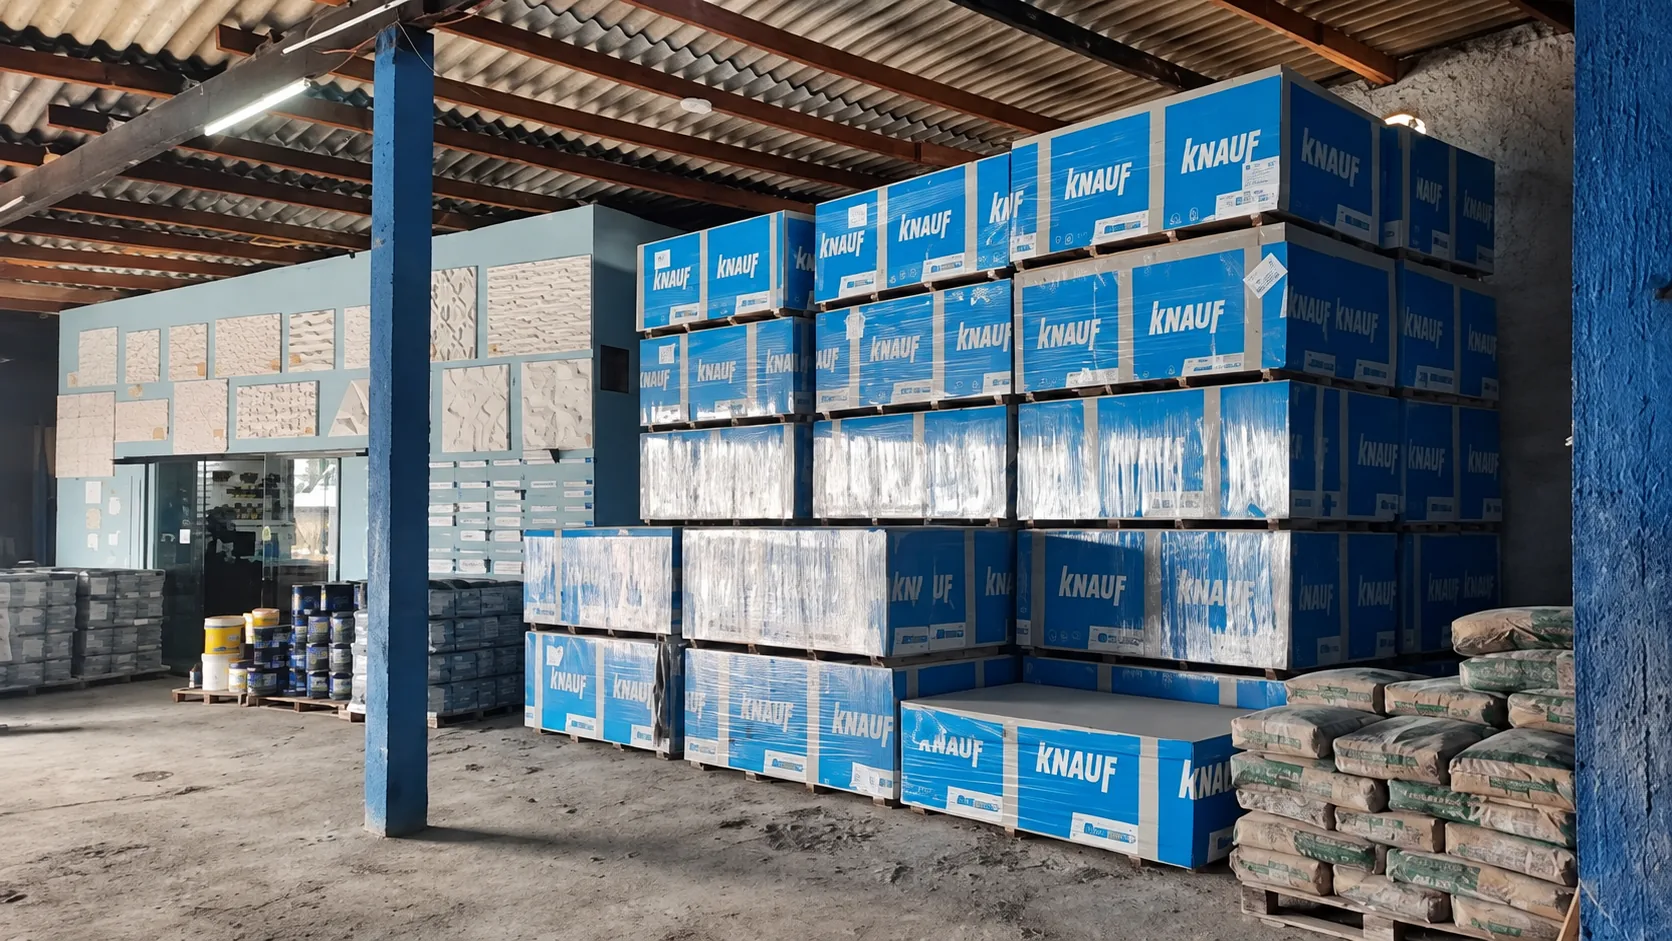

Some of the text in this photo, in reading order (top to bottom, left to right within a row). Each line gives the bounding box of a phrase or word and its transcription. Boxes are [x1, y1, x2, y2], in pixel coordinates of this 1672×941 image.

[1180, 128, 1262, 175] KNAUF
[1301, 127, 1361, 187] KNAUF
[1064, 161, 1133, 200] KNAUF
[898, 210, 952, 242] KNAUF
[1462, 189, 1494, 231] KNAUF
[819, 230, 865, 259] KNAUF
[653, 266, 691, 291] KNAUF
[716, 252, 760, 279] KNAUF
[956, 321, 1012, 352] KNAUF
[1036, 317, 1102, 351] KNAUF
[1148, 299, 1226, 336] KNAUF
[1335, 297, 1379, 344] KNAUF
[1403, 306, 1443, 349] KNAUF
[815, 347, 840, 373] AUF
[869, 335, 921, 364] KNAUF
[697, 359, 737, 384] KNAUF
[1357, 433, 1399, 475] KNAUF
[1408, 438, 1446, 477] KNAUF
[1058, 565, 1127, 607] KNAUF
[1357, 575, 1398, 612] KNAUF
[550, 666, 587, 700] KNAUF
[740, 692, 794, 733] KNAUF
[832, 702, 894, 748] KNAUF
[1035, 741, 1118, 794] KNAUF
